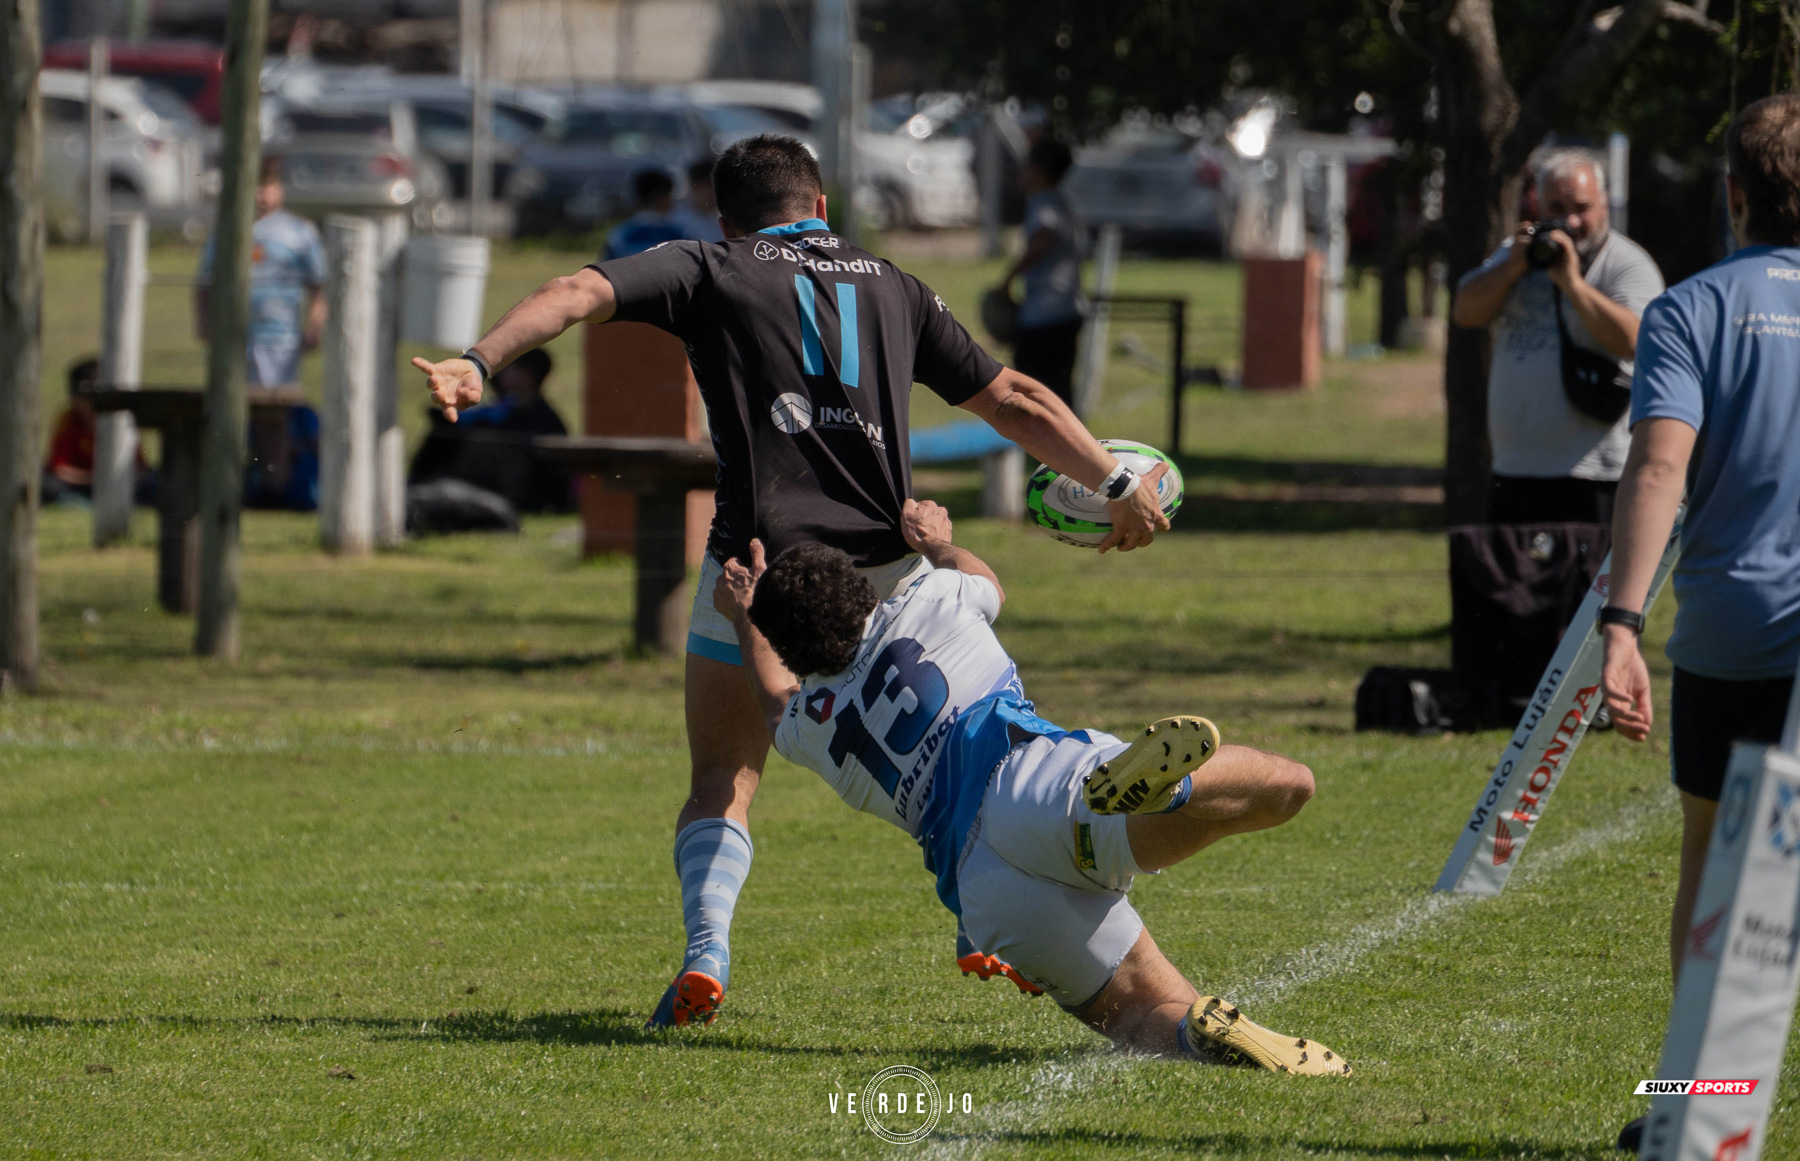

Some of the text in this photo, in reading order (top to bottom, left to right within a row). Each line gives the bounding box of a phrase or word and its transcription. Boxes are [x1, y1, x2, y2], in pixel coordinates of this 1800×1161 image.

[794, 273, 860, 388] 11
[828, 637, 950, 800] 13
[1511, 684, 1600, 827] HONDA
[1468, 759, 1514, 833] Moto
